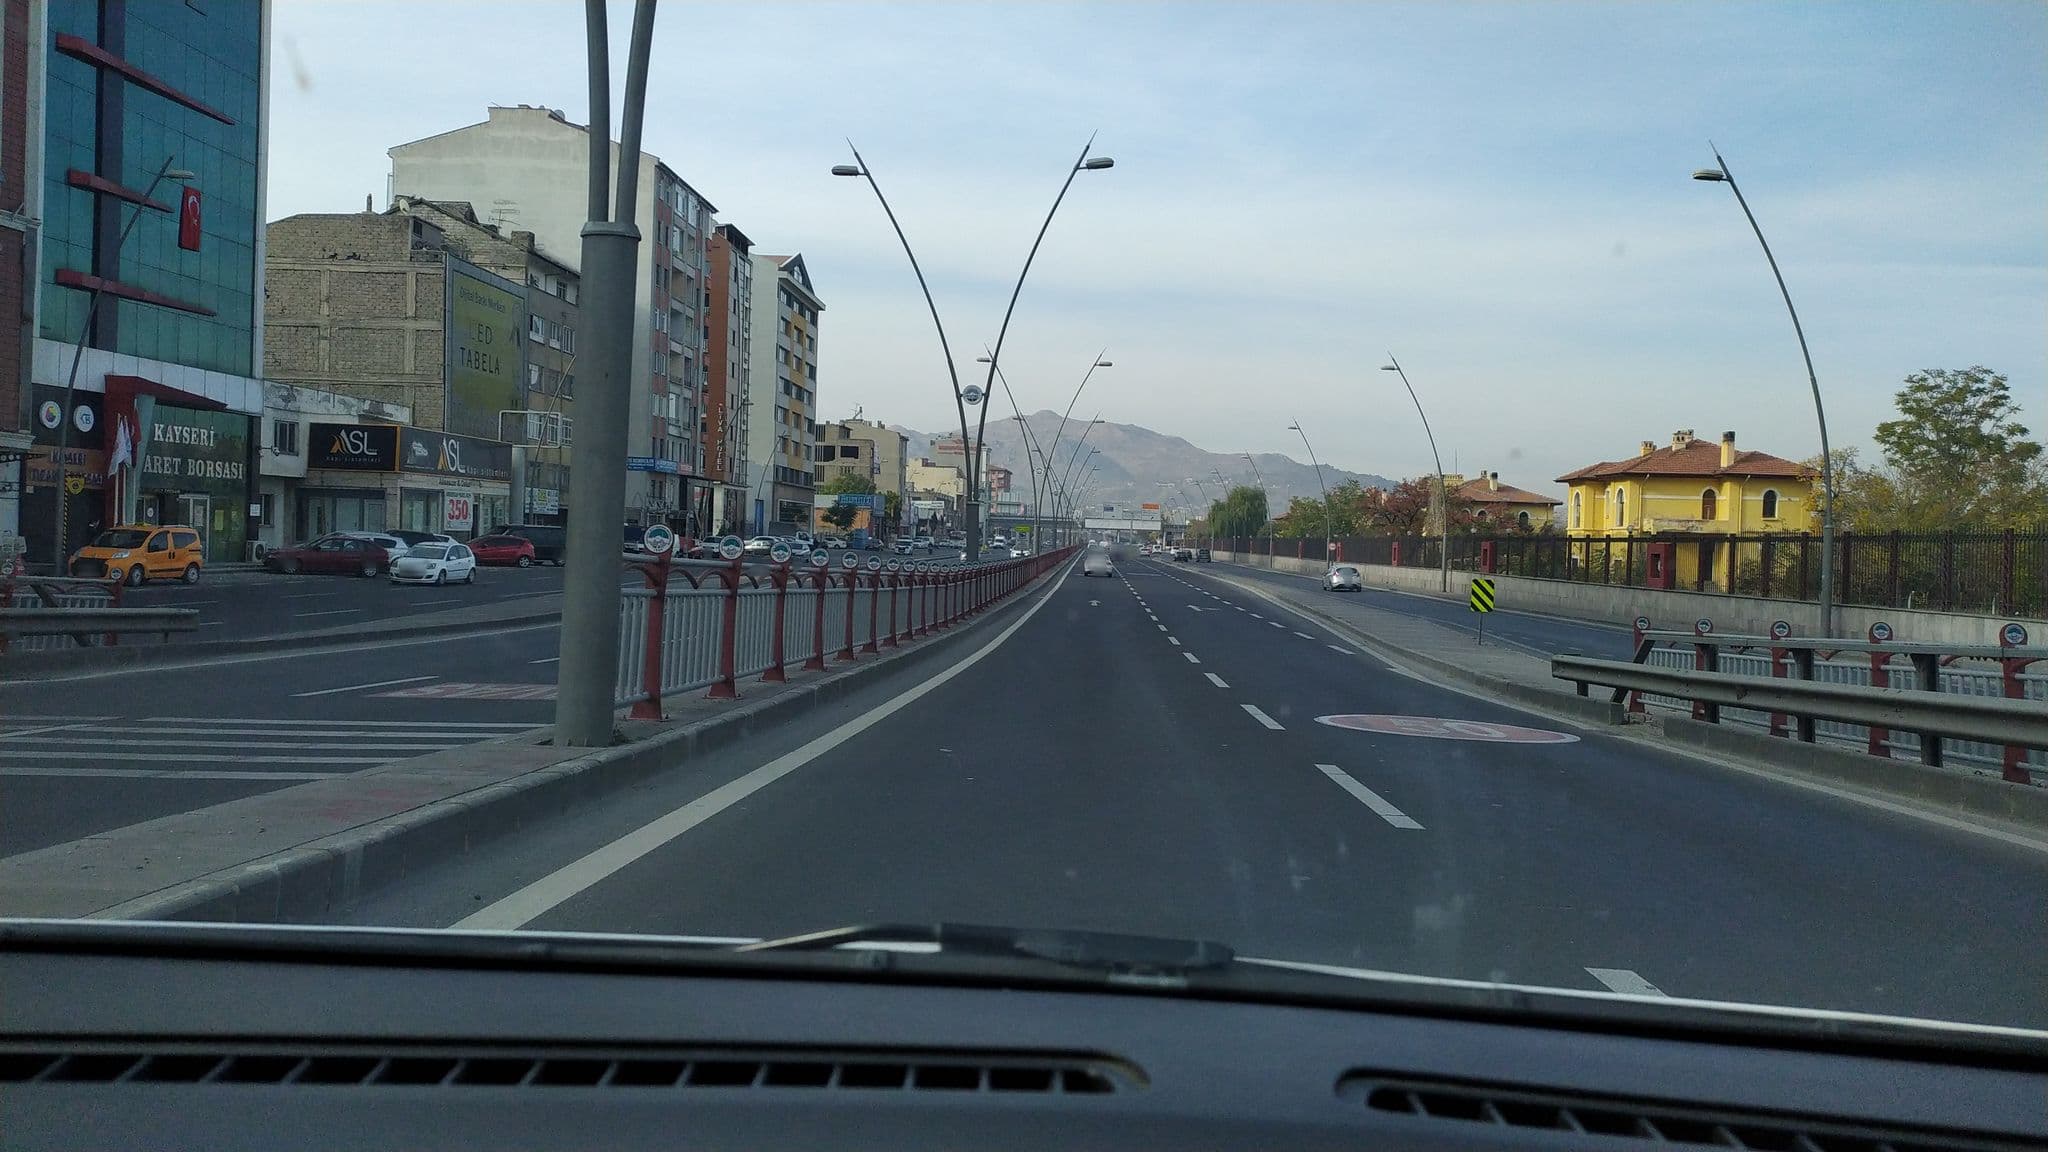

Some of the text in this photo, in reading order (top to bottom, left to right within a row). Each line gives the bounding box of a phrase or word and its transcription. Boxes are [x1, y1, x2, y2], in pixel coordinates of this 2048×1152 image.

[459, 346, 500, 376] TABELA
[153, 423, 215, 447] KAYSERİ
[329, 429, 378, 456] ASL
[437, 437, 466, 474] ASL
[187, 457, 244, 480] BORSASI
[447, 499, 469, 520] 350
